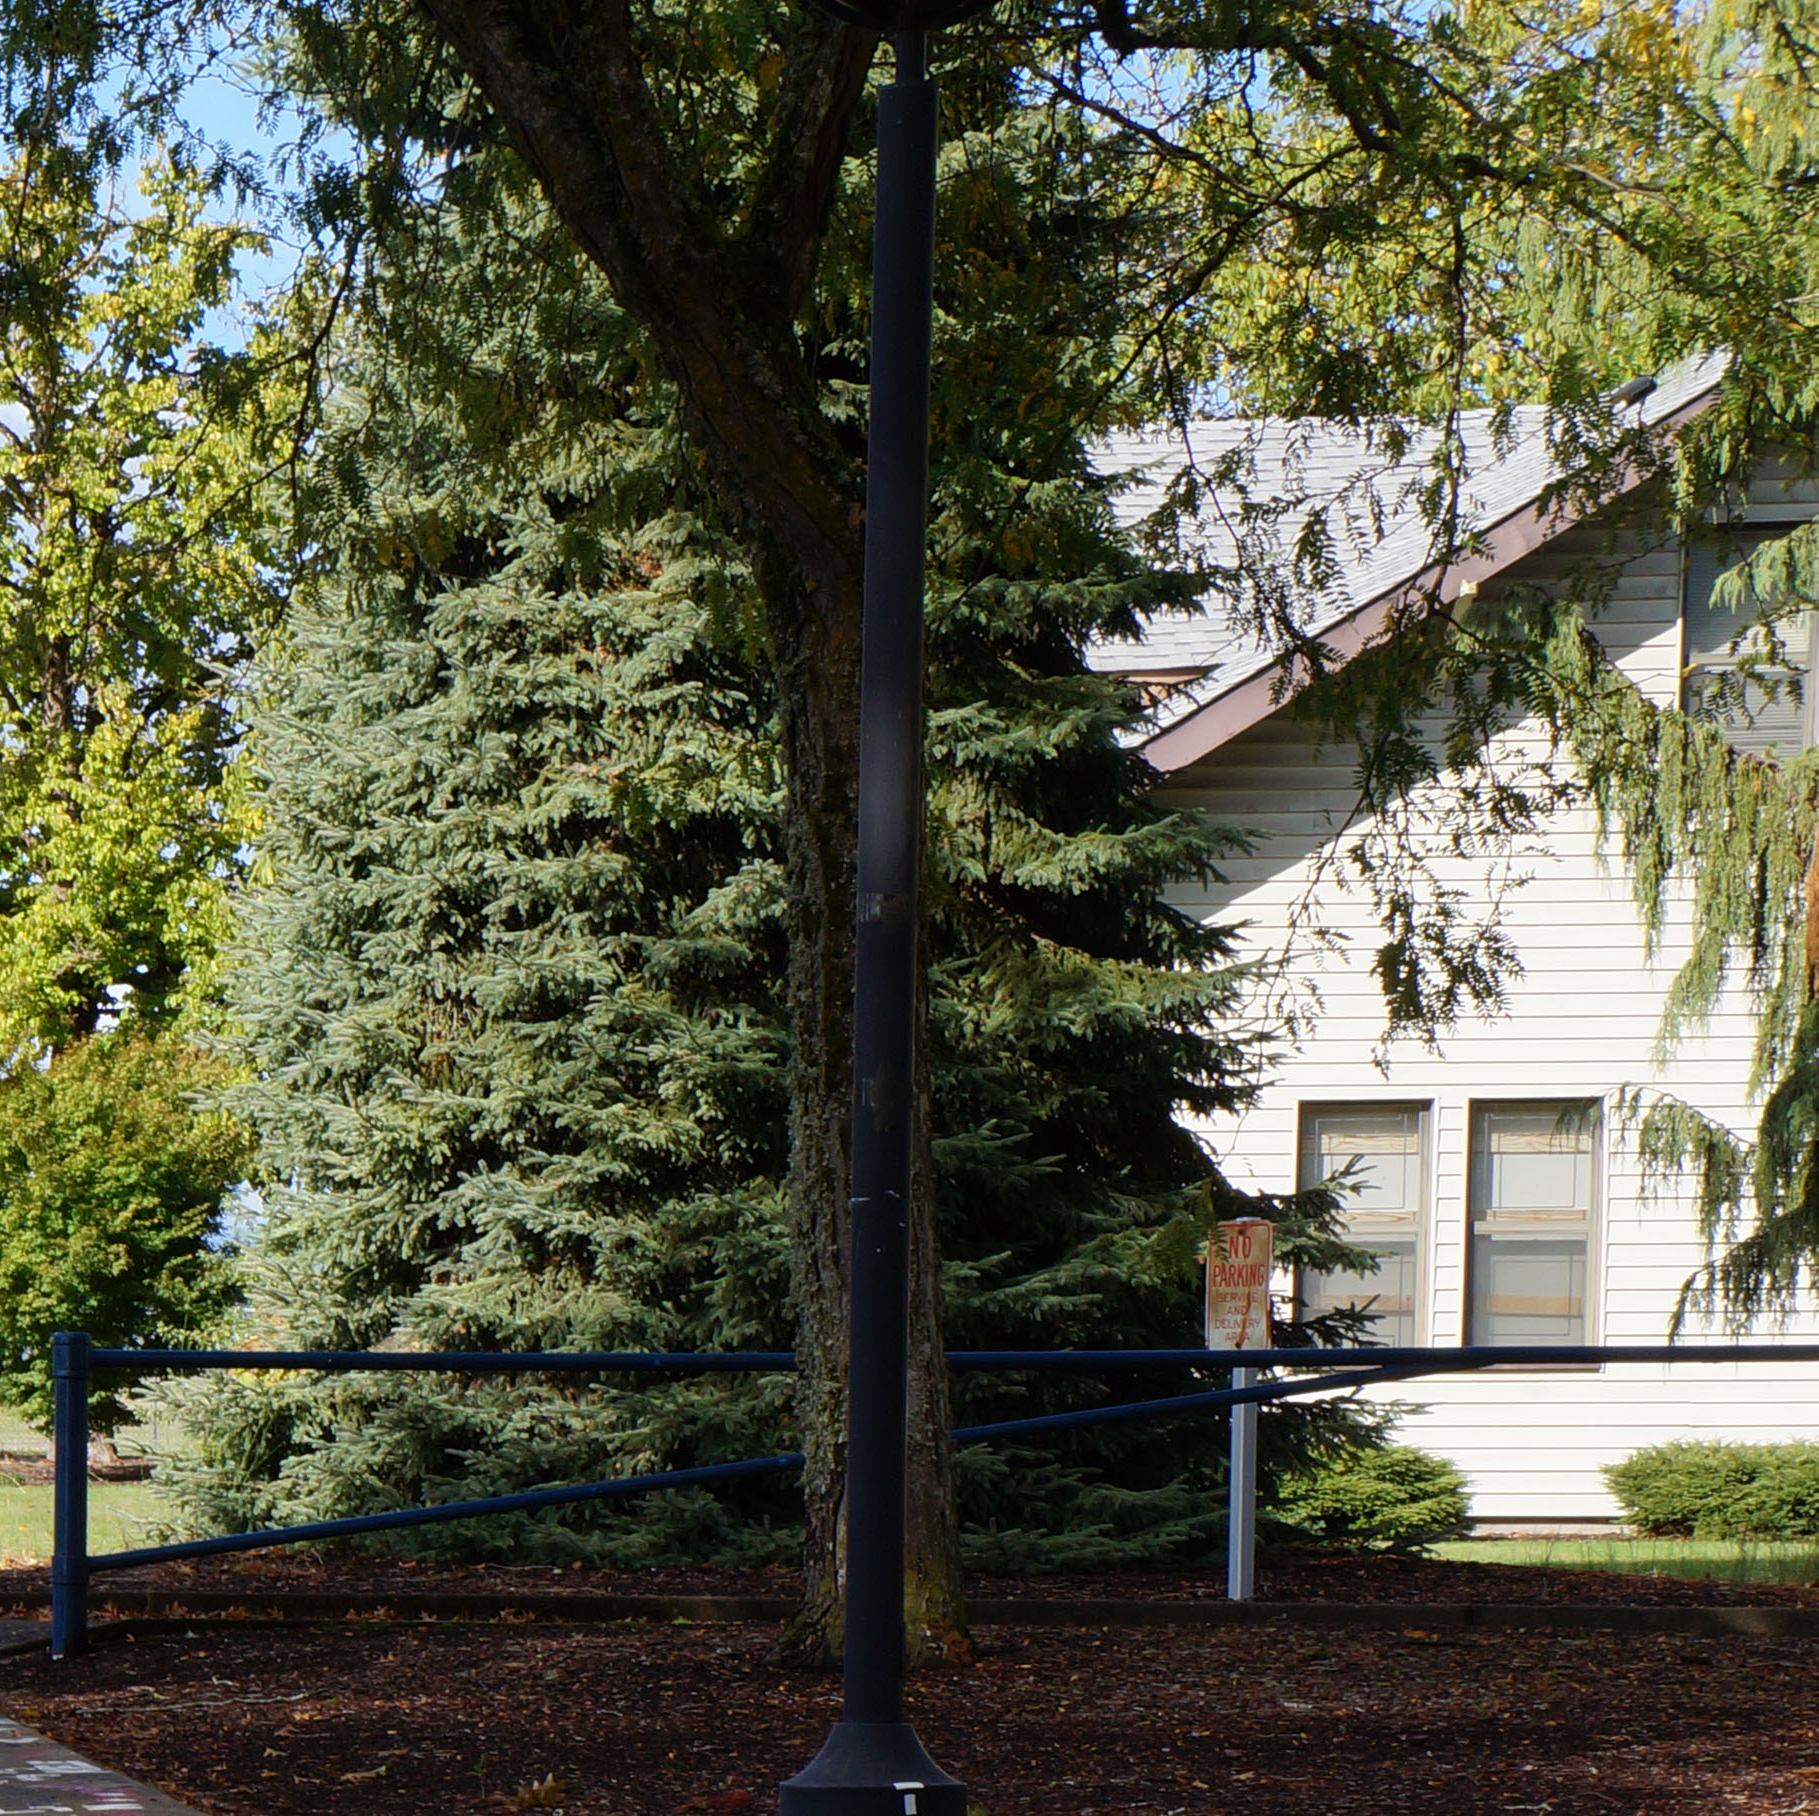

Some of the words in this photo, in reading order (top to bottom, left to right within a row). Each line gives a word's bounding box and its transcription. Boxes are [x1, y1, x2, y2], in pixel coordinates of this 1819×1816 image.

[1228, 1234, 1253, 1261] NO
[1212, 1262, 1265, 1287] PARKING
[1217, 1290, 1258, 1304] SERVICE
[1227, 1305, 1249, 1316] AND
[1214, 1317, 1261, 1331] DELIVERY
